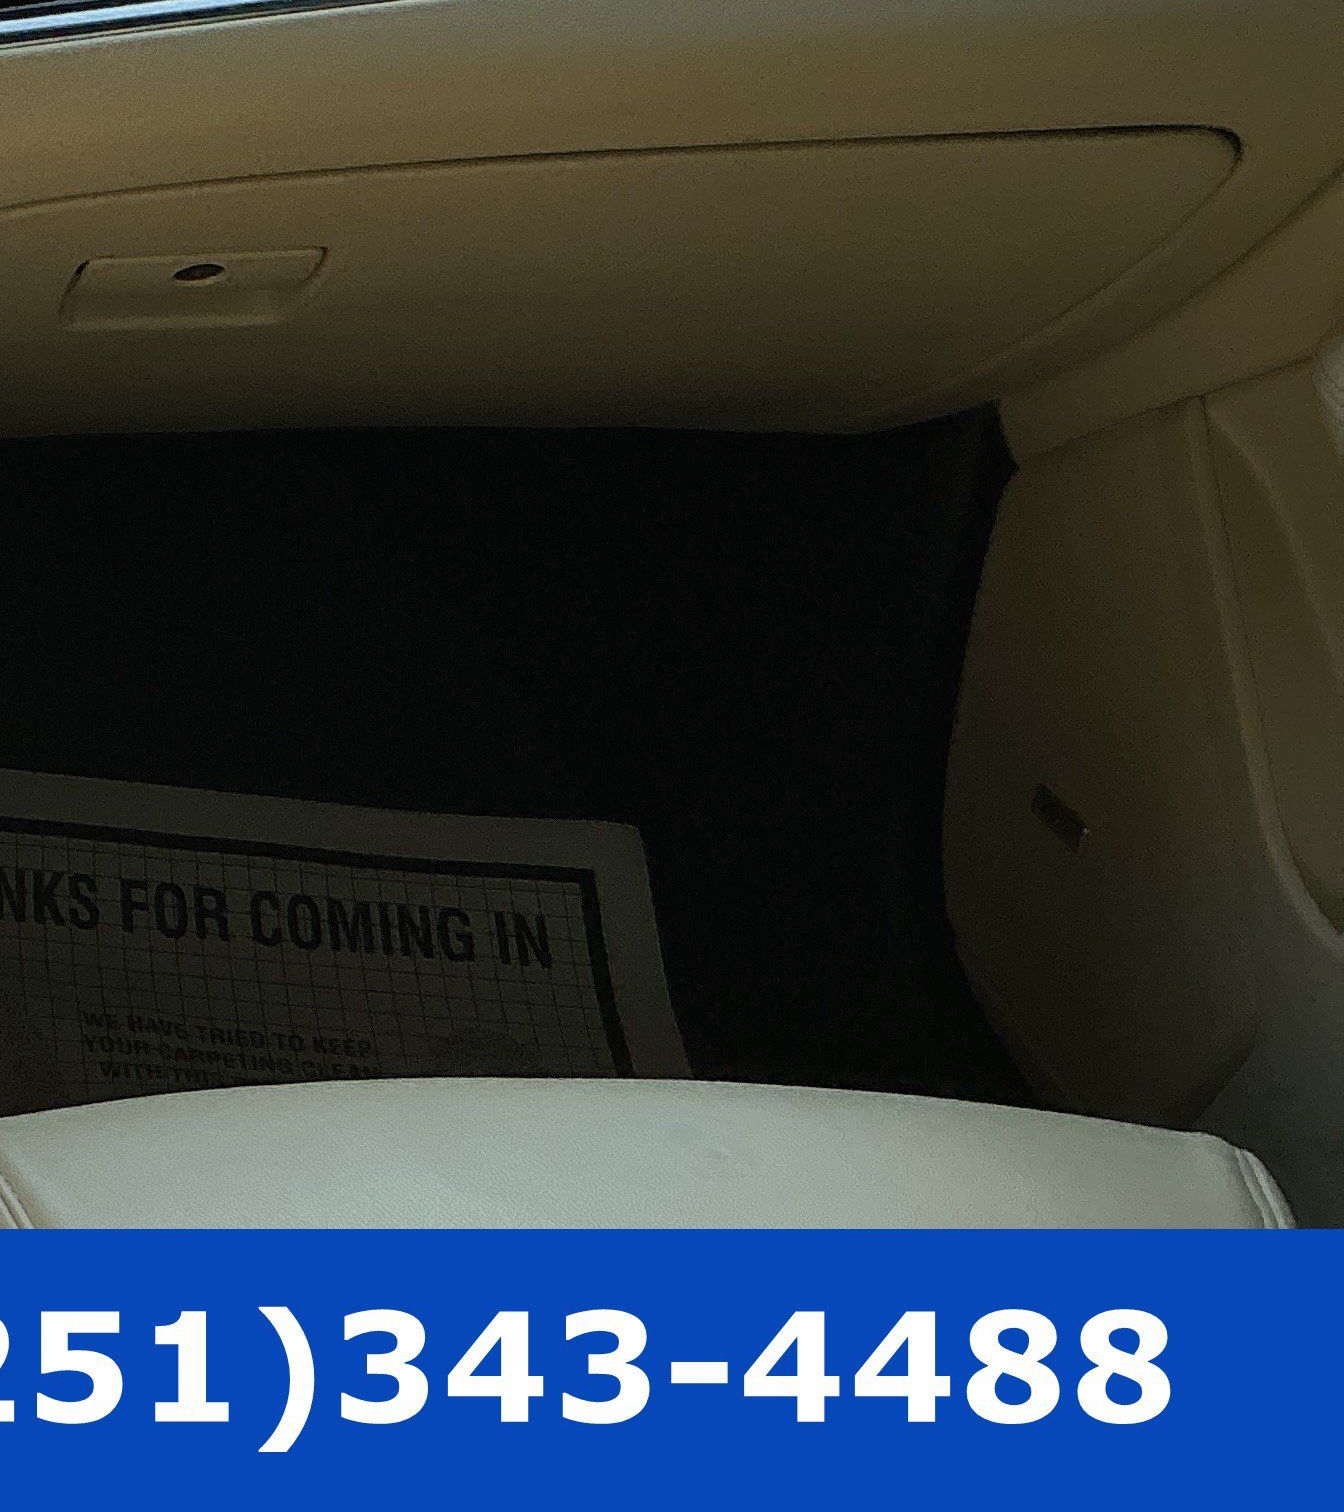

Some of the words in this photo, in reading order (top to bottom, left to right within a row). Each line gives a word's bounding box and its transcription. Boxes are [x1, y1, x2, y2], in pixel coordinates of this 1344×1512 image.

[118, 877, 232, 942] FOR
[248, 889, 478, 964] COMING
[493, 909, 554, 969] IN
[81, 1033, 151, 1056] YOUR
[157, 1042, 296, 1076] CARPETING
[82, 1011, 122, 1030] WE
[126, 1014, 189, 1041] HAVE
[195, 1024, 266, 1049] TRIED
[272, 1032, 306, 1052] TO
[312, 1036, 373, 1059] KEEP
[99, 1060, 164, 1081] WITH
